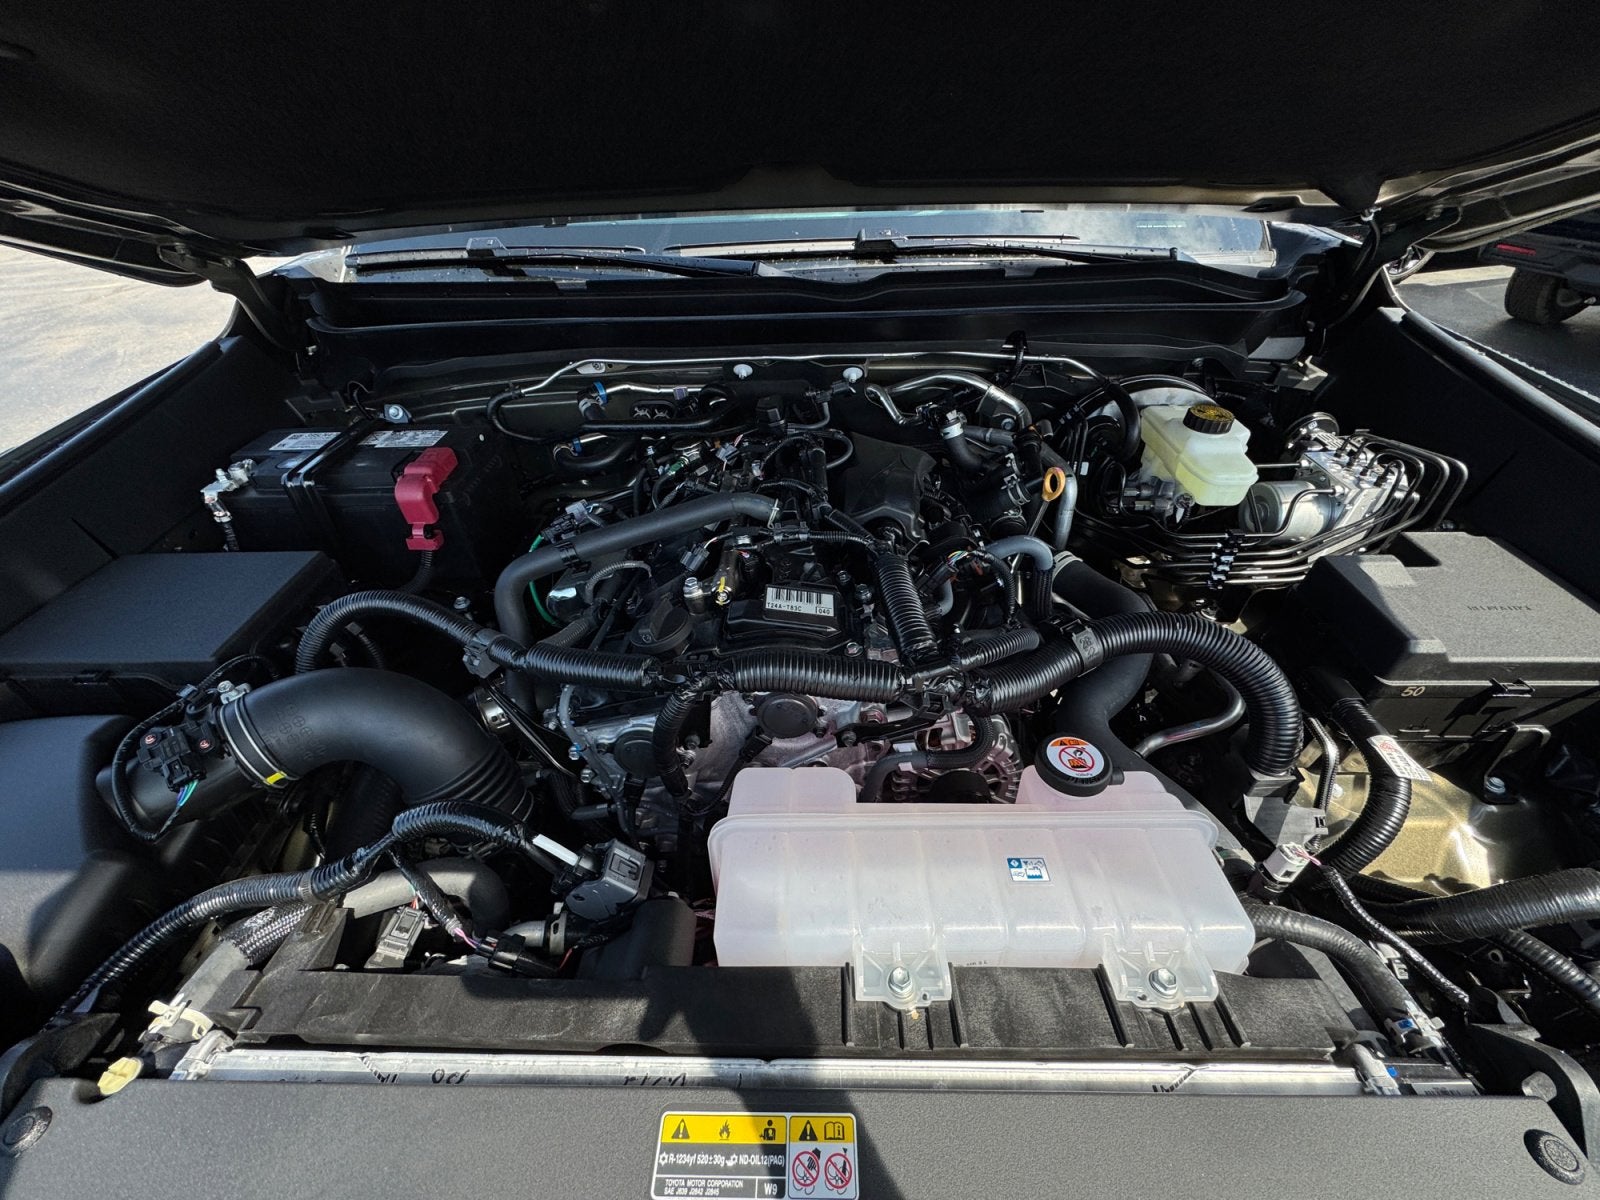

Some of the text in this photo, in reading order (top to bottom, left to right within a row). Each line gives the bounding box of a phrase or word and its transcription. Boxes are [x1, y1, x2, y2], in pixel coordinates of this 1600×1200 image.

[1401, 686, 1426, 697] 50
[669, 1153, 697, 1167] R-1234yf
[739, 1154, 785, 1168] ND-OIL12(PAG)
[665, 1178, 744, 1188] TOYOTA MOTOR CORPORATION
[664, 1186, 675, 1195] SAE
[764, 1182, 778, 1196] W9
